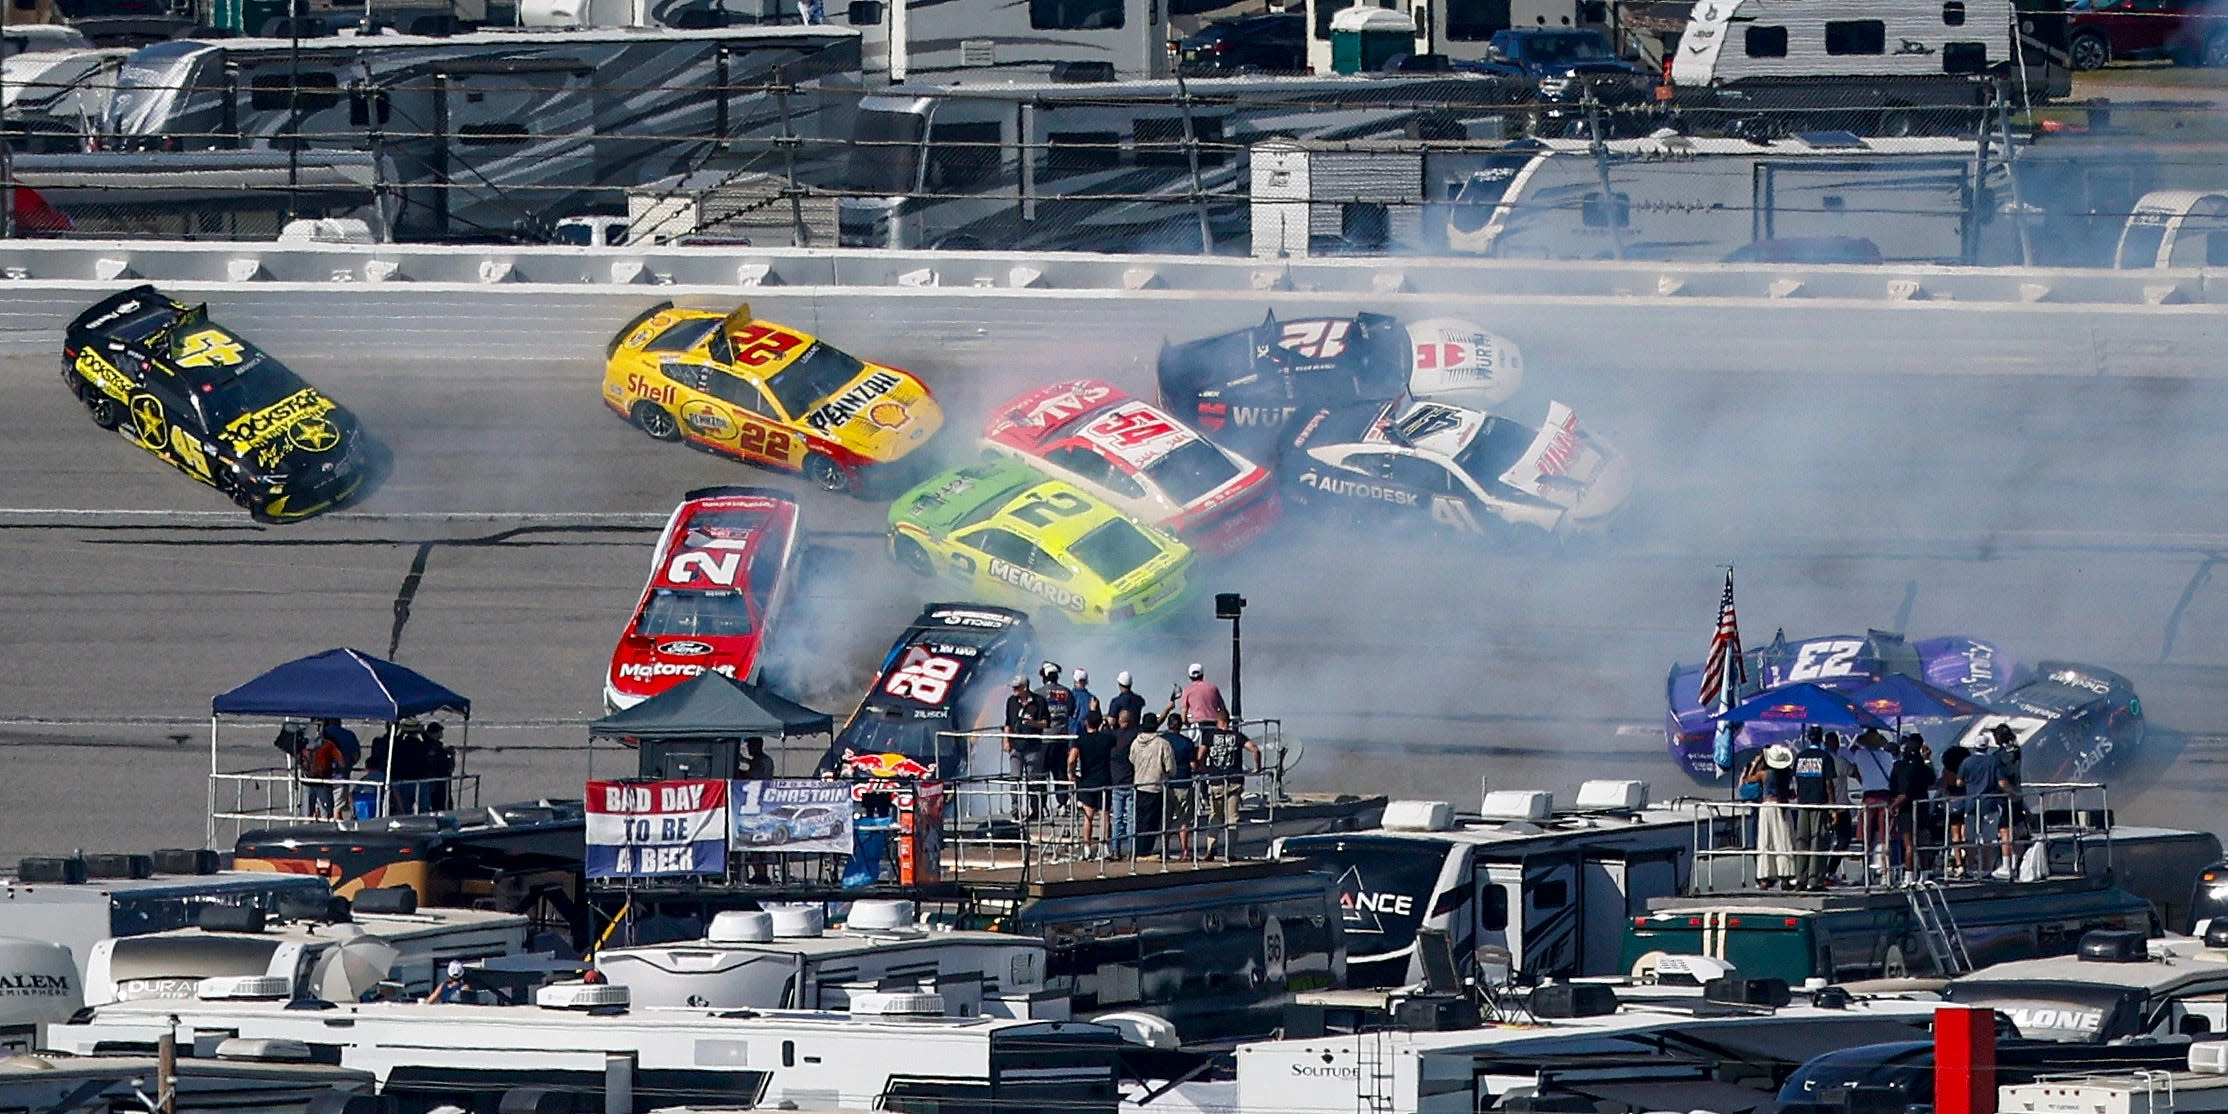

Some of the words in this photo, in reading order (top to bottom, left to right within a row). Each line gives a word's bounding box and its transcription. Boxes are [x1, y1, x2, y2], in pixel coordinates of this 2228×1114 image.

[732, 324, 804, 367] 22
[1278, 320, 1352, 359] 12
[627, 372, 677, 405] Shell
[171, 424, 215, 480] 45
[740, 421, 791, 462] 22
[1319, 476, 1419, 506] AUTODESK
[1008, 492, 1094, 528] 2
[989, 557, 1087, 613] MENARDS
[667, 642, 705, 654] Ford
[606, 786, 652, 812] BAD
[661, 783, 705, 811] DAY
[740, 780, 762, 815] 1
[763, 787, 849, 803] CHASTAIN
[623, 817, 650, 842] TO
[662, 817, 688, 841] BE
[616, 847, 632, 873] A
[640, 846, 694, 873] BEER
[1340, 891, 1413, 916] ANCE
[0, 975, 70, 990] ALEM
[0, 989, 69, 997] EMISPHERE
[1291, 1063, 1360, 1078] SOLITUDE
